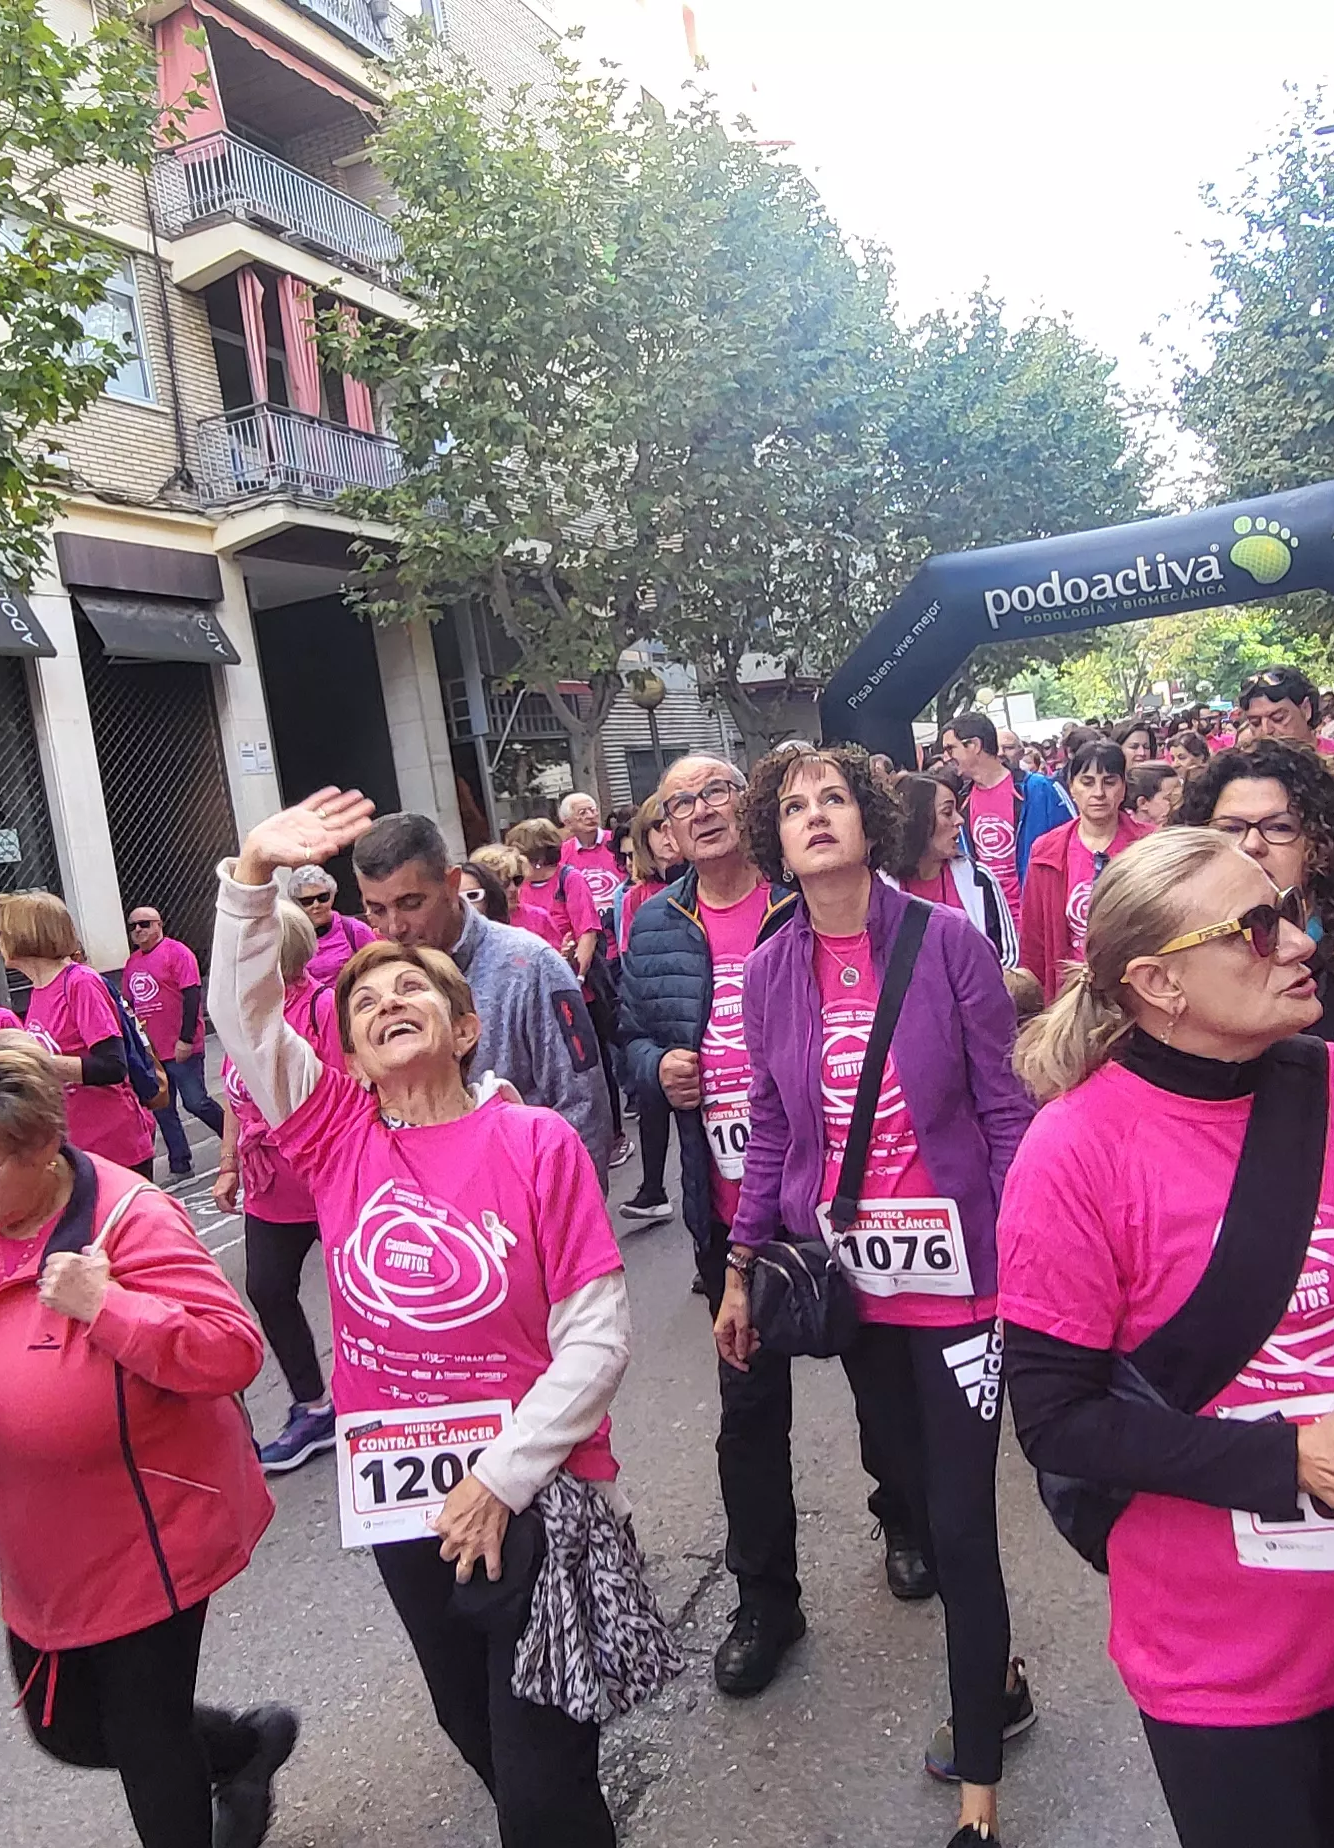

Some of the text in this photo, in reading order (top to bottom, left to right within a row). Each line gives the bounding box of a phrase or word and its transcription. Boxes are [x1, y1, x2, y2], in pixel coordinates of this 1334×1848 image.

[1109, 602, 1119, 612] Y
[847, 599, 942, 710] Pisa bien, vive mejor
[883, 1219, 894, 1230] EL
[897, 1217, 945, 1231] CÁNCER
[385, 1251, 430, 1273] JUNTOS
[840, 1235, 953, 1271] 1076
[358, 1426, 496, 1452] CONTRA EL CÁNCER
[404, 1422, 446, 1435] HUESCA
[359, 1447, 488, 1505] 120
